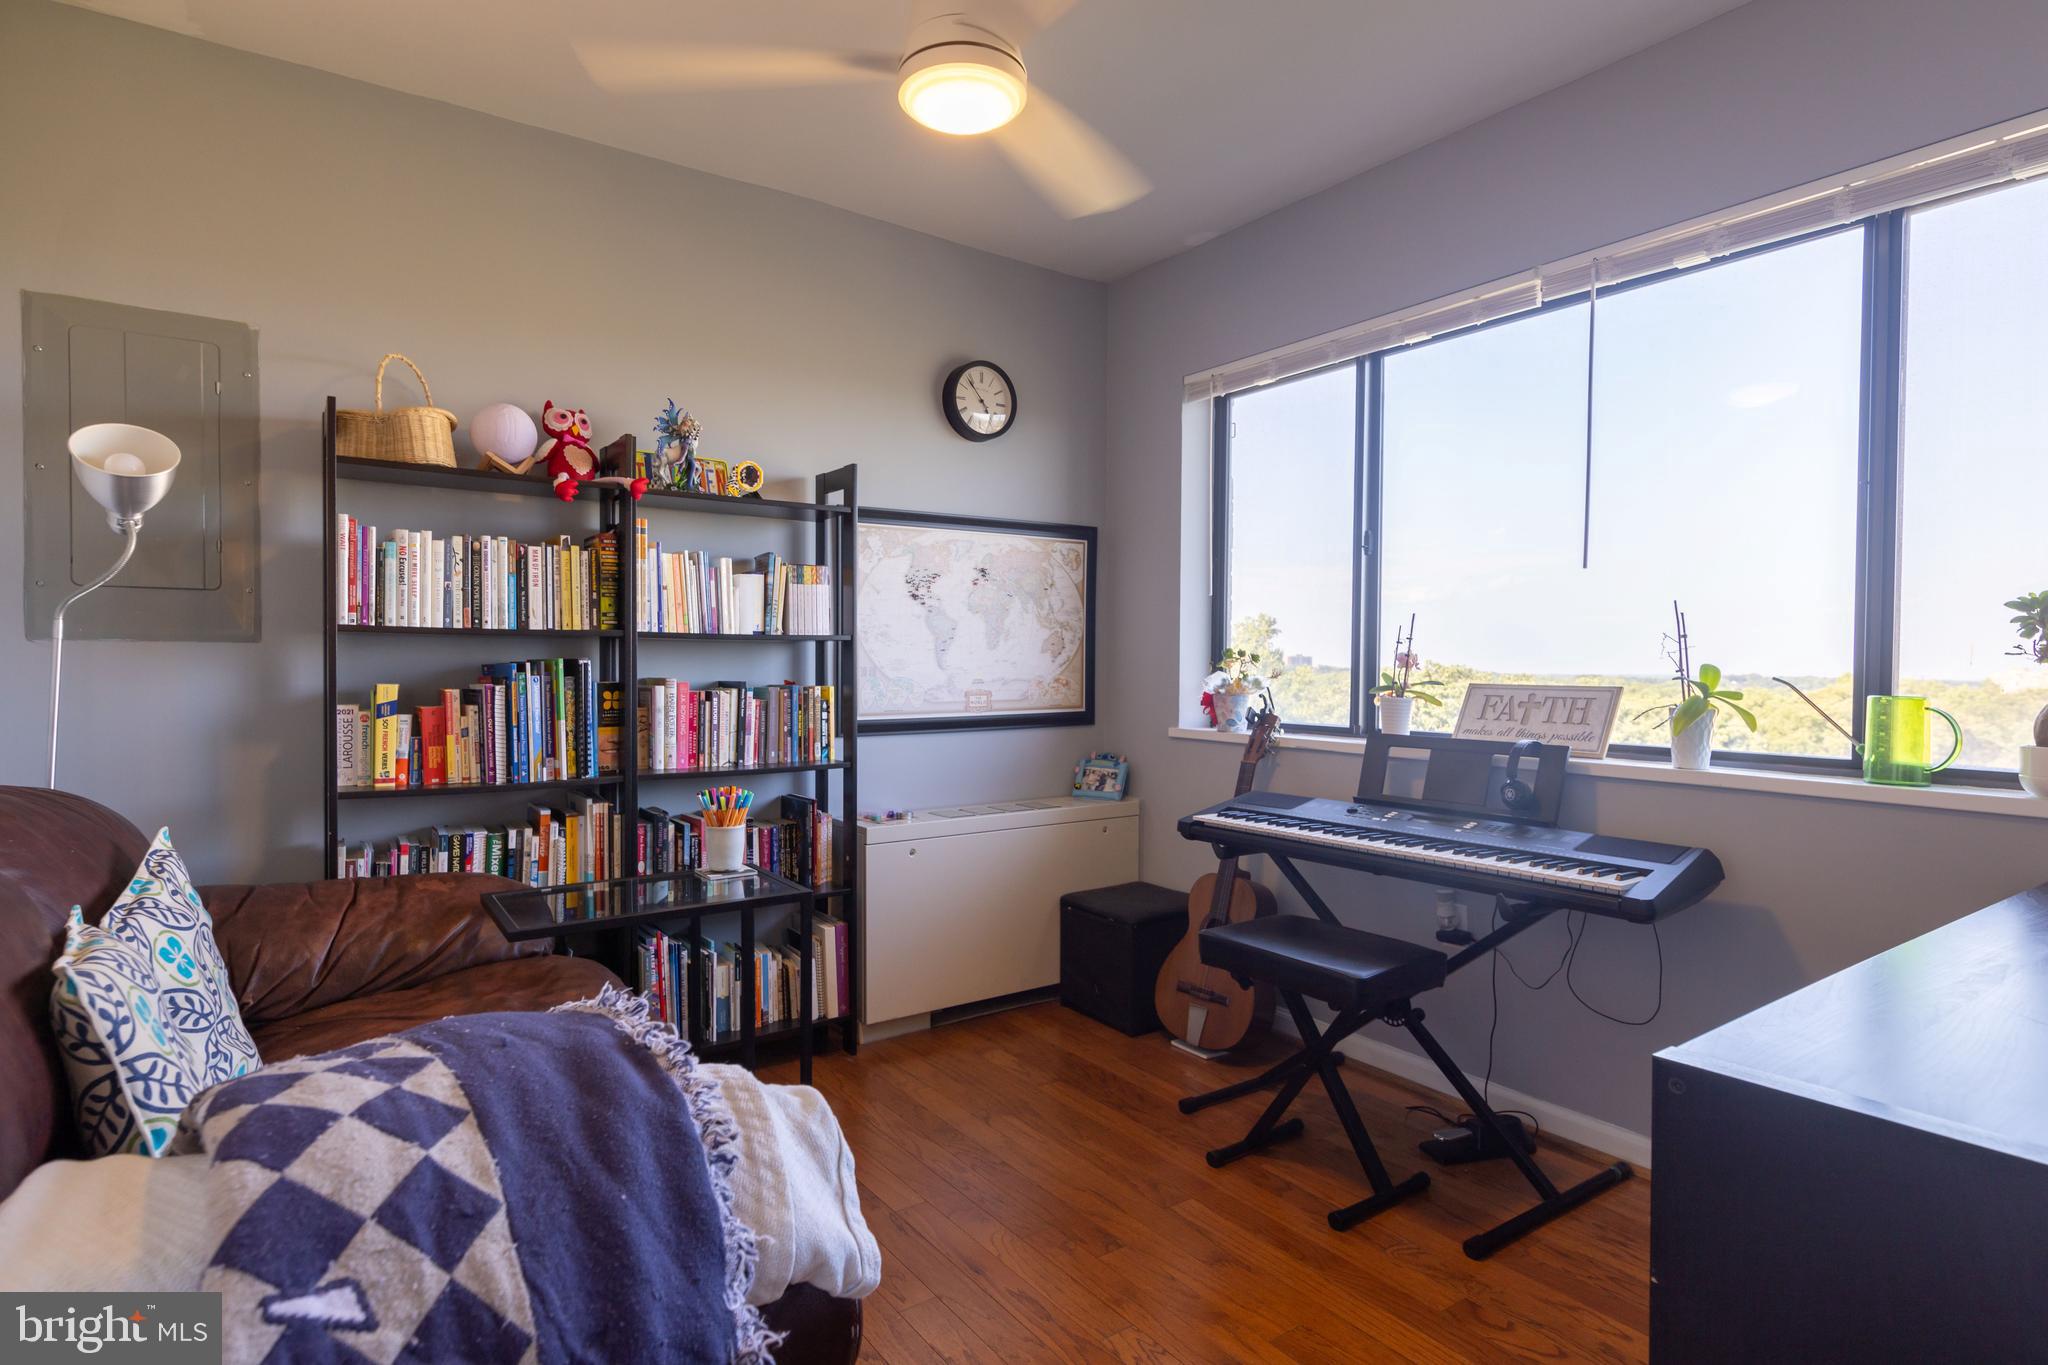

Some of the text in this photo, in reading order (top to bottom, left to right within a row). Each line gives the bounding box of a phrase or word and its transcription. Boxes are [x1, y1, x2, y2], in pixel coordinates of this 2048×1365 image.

[399, 545, 407, 586] NO Excuses!
[343, 718, 354, 769] LAROUSSE
[361, 725, 369, 750] french
[1462, 725, 1596, 744] makes all things possible
[452, 834, 460, 857] GAMES
[491, 845, 502, 876] Mixer
